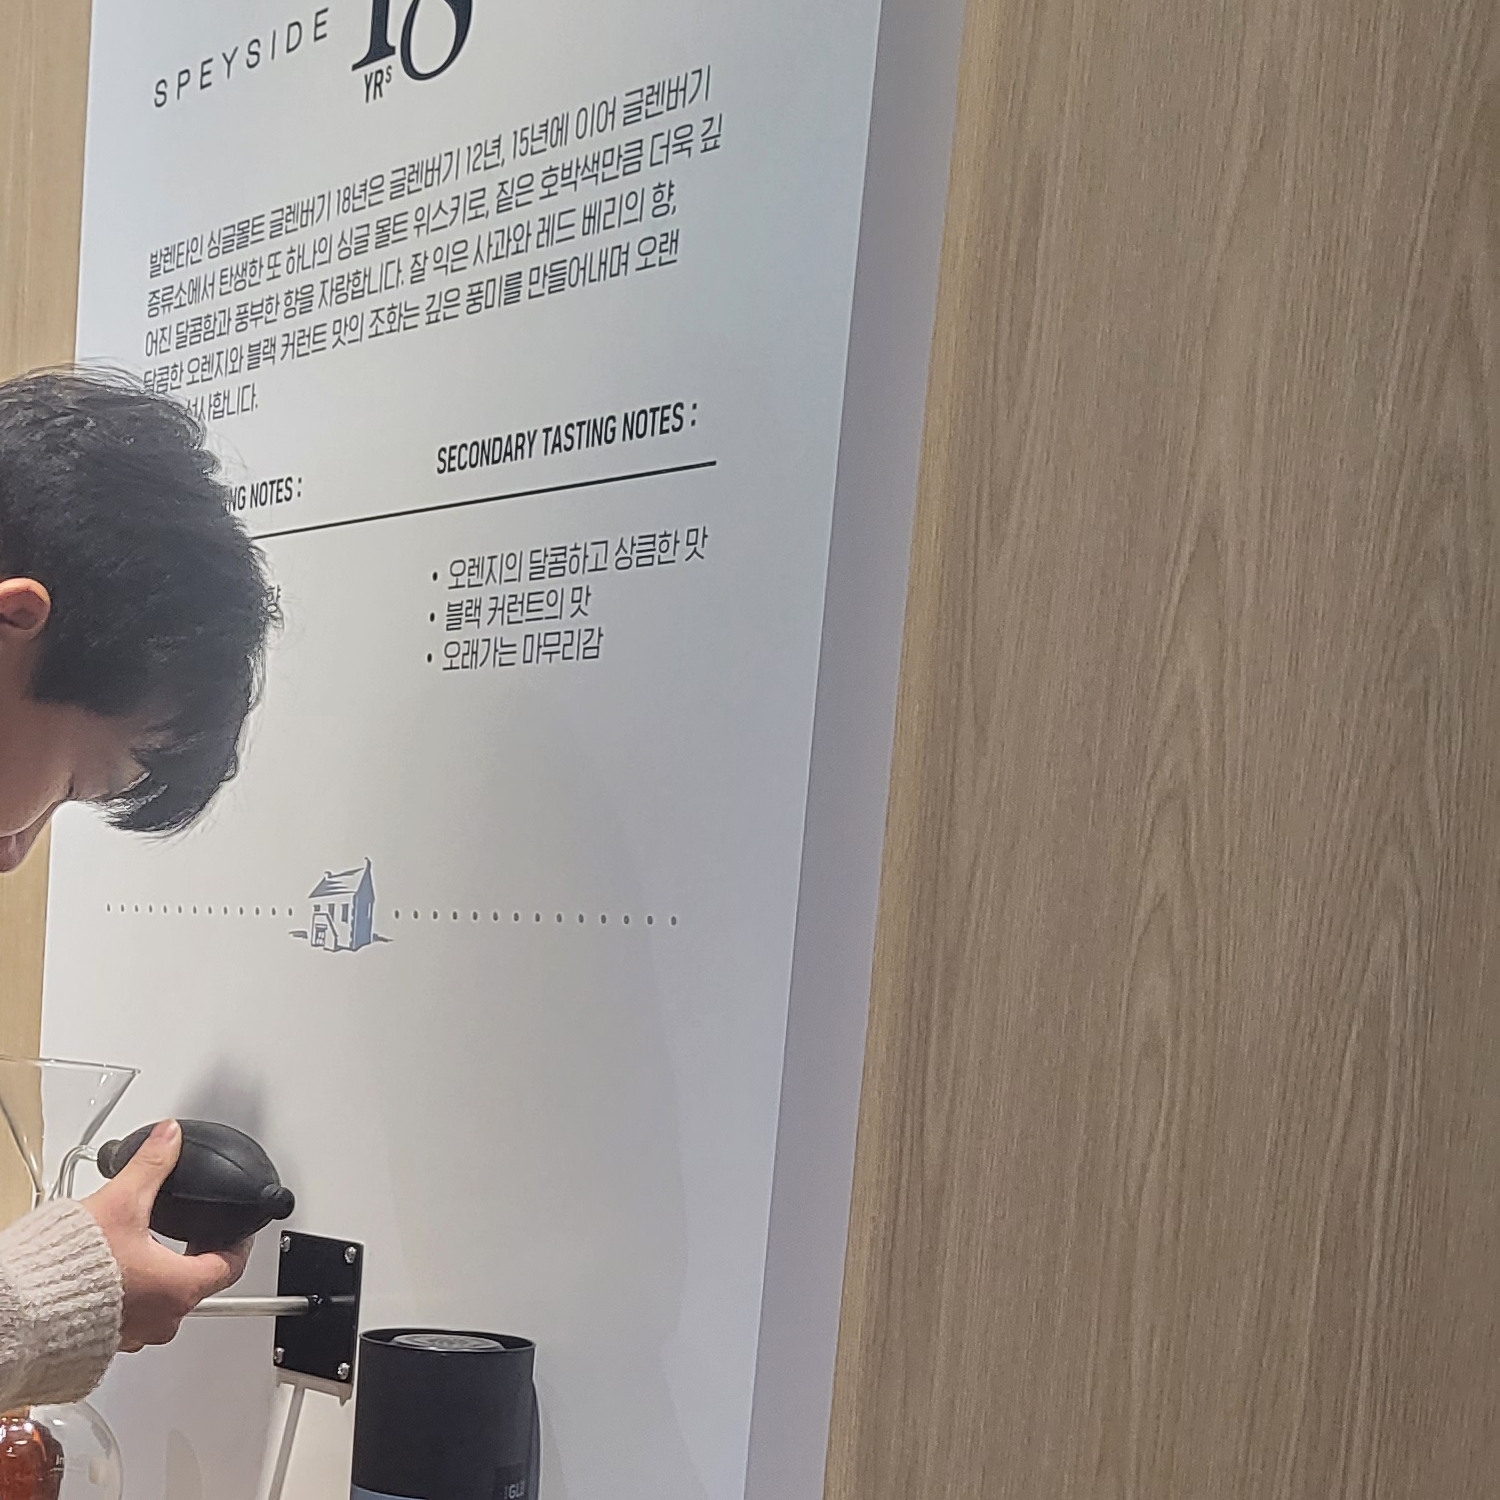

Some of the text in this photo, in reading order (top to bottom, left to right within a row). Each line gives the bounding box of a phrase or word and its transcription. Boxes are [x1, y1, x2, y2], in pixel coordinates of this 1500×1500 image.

[153, 7, 330, 108] SPEYSIDE
[147, 112, 723, 318] 증류소에서 탄생한 또 하나의 싱글 몰트 위스키로, 짙은 호박색만큼 더욱 깊
[149, 64, 711, 279] 발렌타인 싱글몰트 글렌버기 18년은 글렌버기 12년, 15년에 이어 글렌버기
[145, 179, 677, 357] 어진 달콤함과 풍부한 향을 자랑합니다. 잘 익은 사과와 레드 베리의 향,
[185, 343, 244, 386] 오렌지와
[246, 335, 277, 372] 블랙
[280, 322, 328, 362] 커런트
[331, 311, 365, 351] 맛의
[367, 299, 421, 339] 조화는
[425, 286, 461, 326] 깊은
[465, 270, 523, 316] 풍미를
[527, 241, 631, 301] 만들어내며
[634, 228, 680, 272] 오랜
[436, 428, 538, 475] SECONDARY
[541, 414, 617, 455] TASTING
[621, 401, 685, 443] NOTES
[249, 476, 294, 509] NOTES
[447, 525, 709, 591] 오렌지의 달콤하고 상큼한 맛
[441, 626, 605, 672] 오래가는 마무리감
[445, 584, 592, 632] 블랙 커런트의 맛
